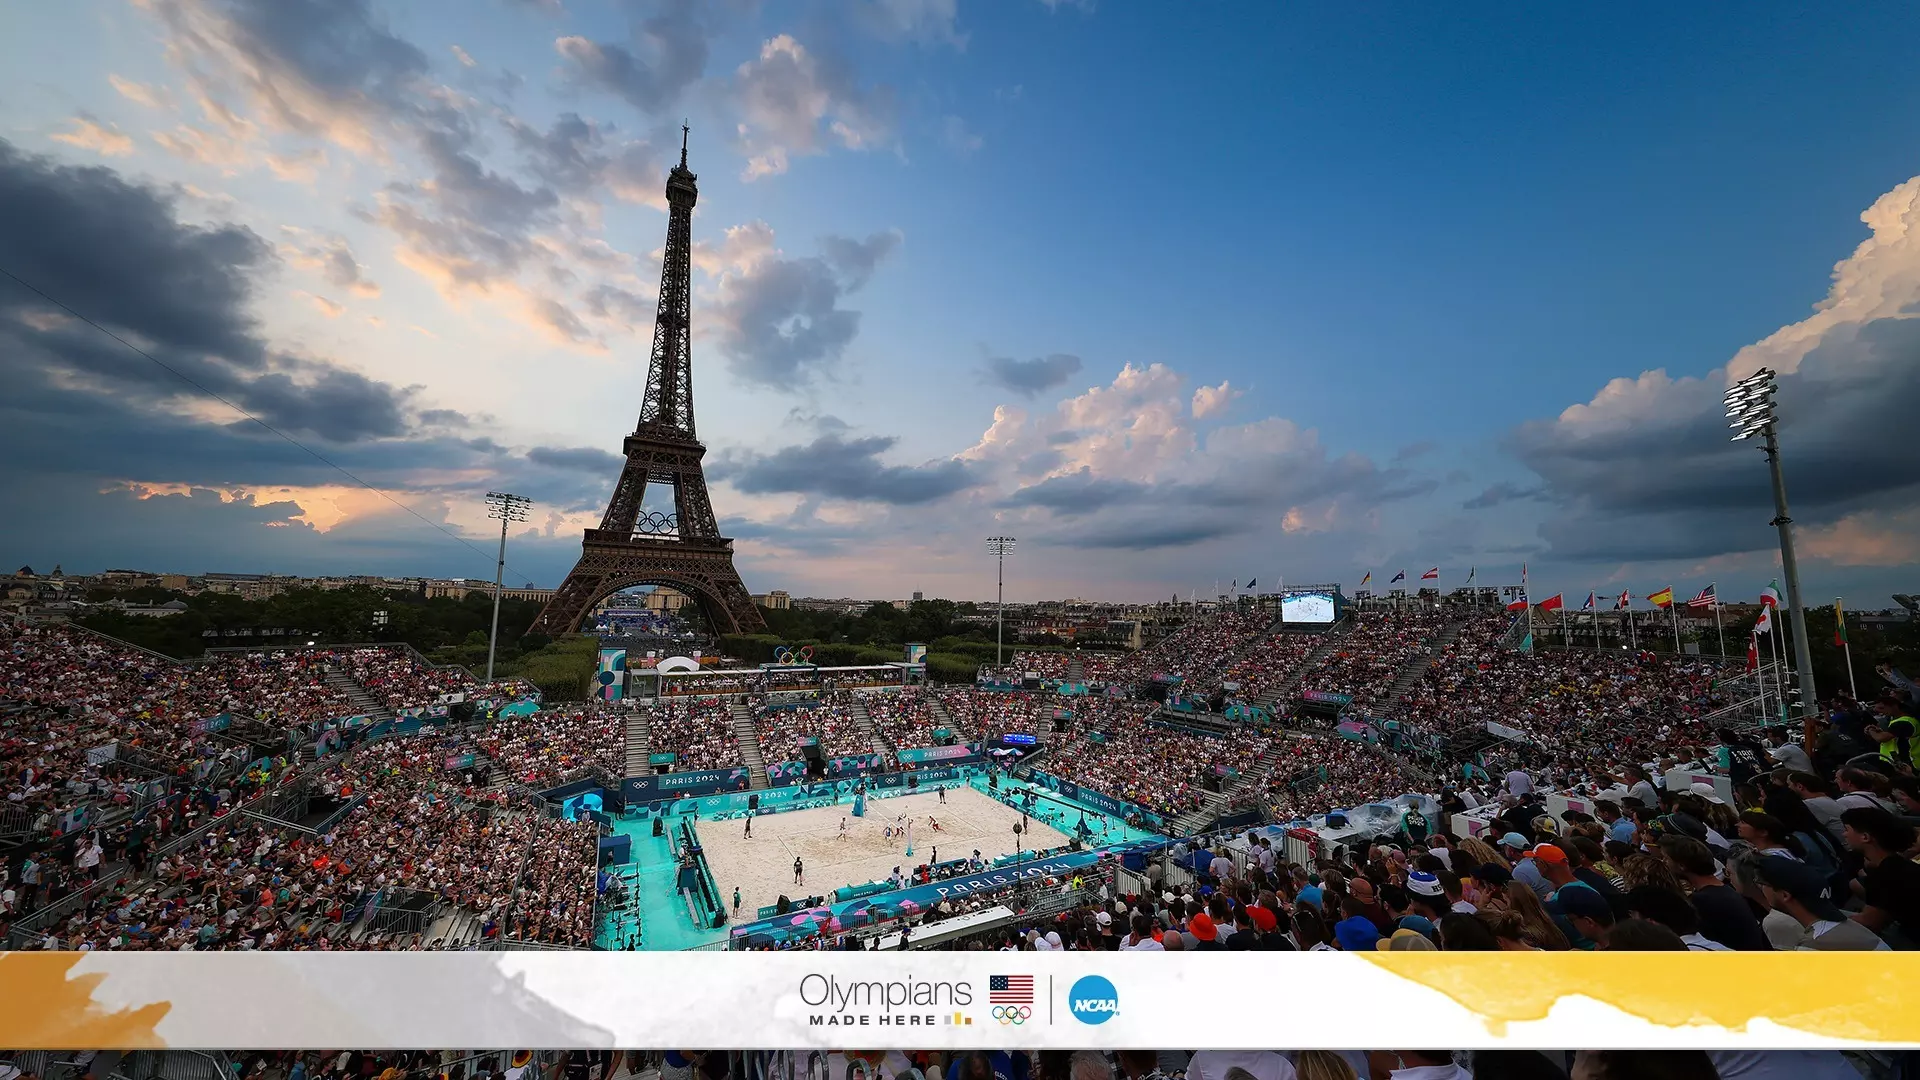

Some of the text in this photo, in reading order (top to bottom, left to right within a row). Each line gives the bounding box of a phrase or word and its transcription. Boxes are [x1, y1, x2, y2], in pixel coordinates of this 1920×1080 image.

[665, 775, 720, 785] PARIS 2024
[736, 791, 787, 802] PAS 2024
[1081, 792, 1116, 811] PARIS 2024
[936, 862, 1071, 896] PARIS 2024
